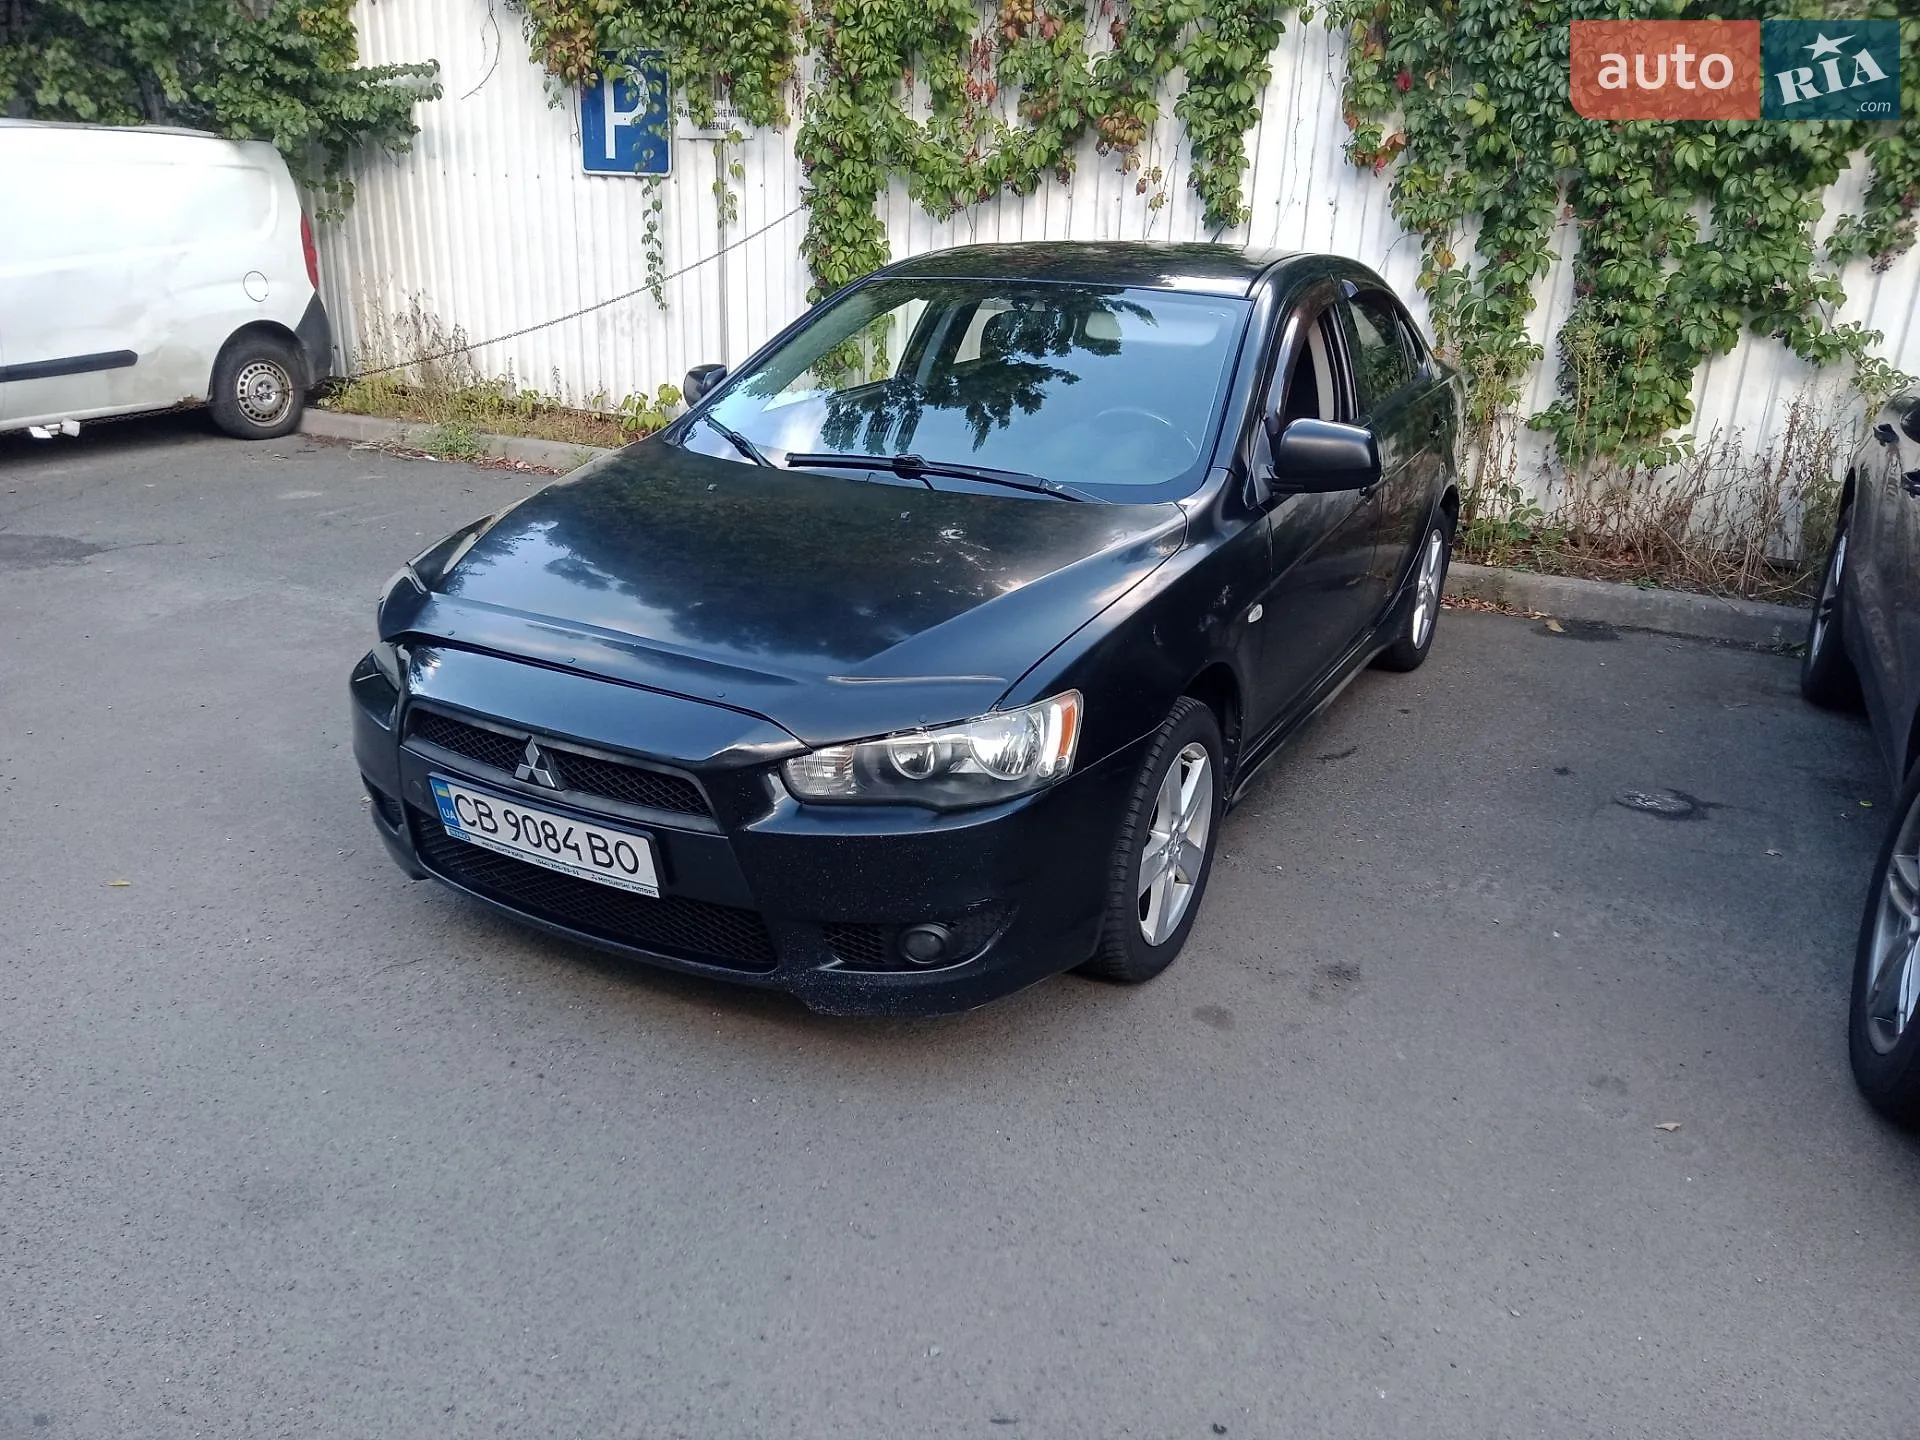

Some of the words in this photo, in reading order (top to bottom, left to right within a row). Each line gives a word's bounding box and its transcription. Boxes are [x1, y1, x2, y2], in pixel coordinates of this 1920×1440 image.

[441, 808, 457, 821] UA
[453, 793, 499, 834] CB
[503, 808, 584, 862] 9084
